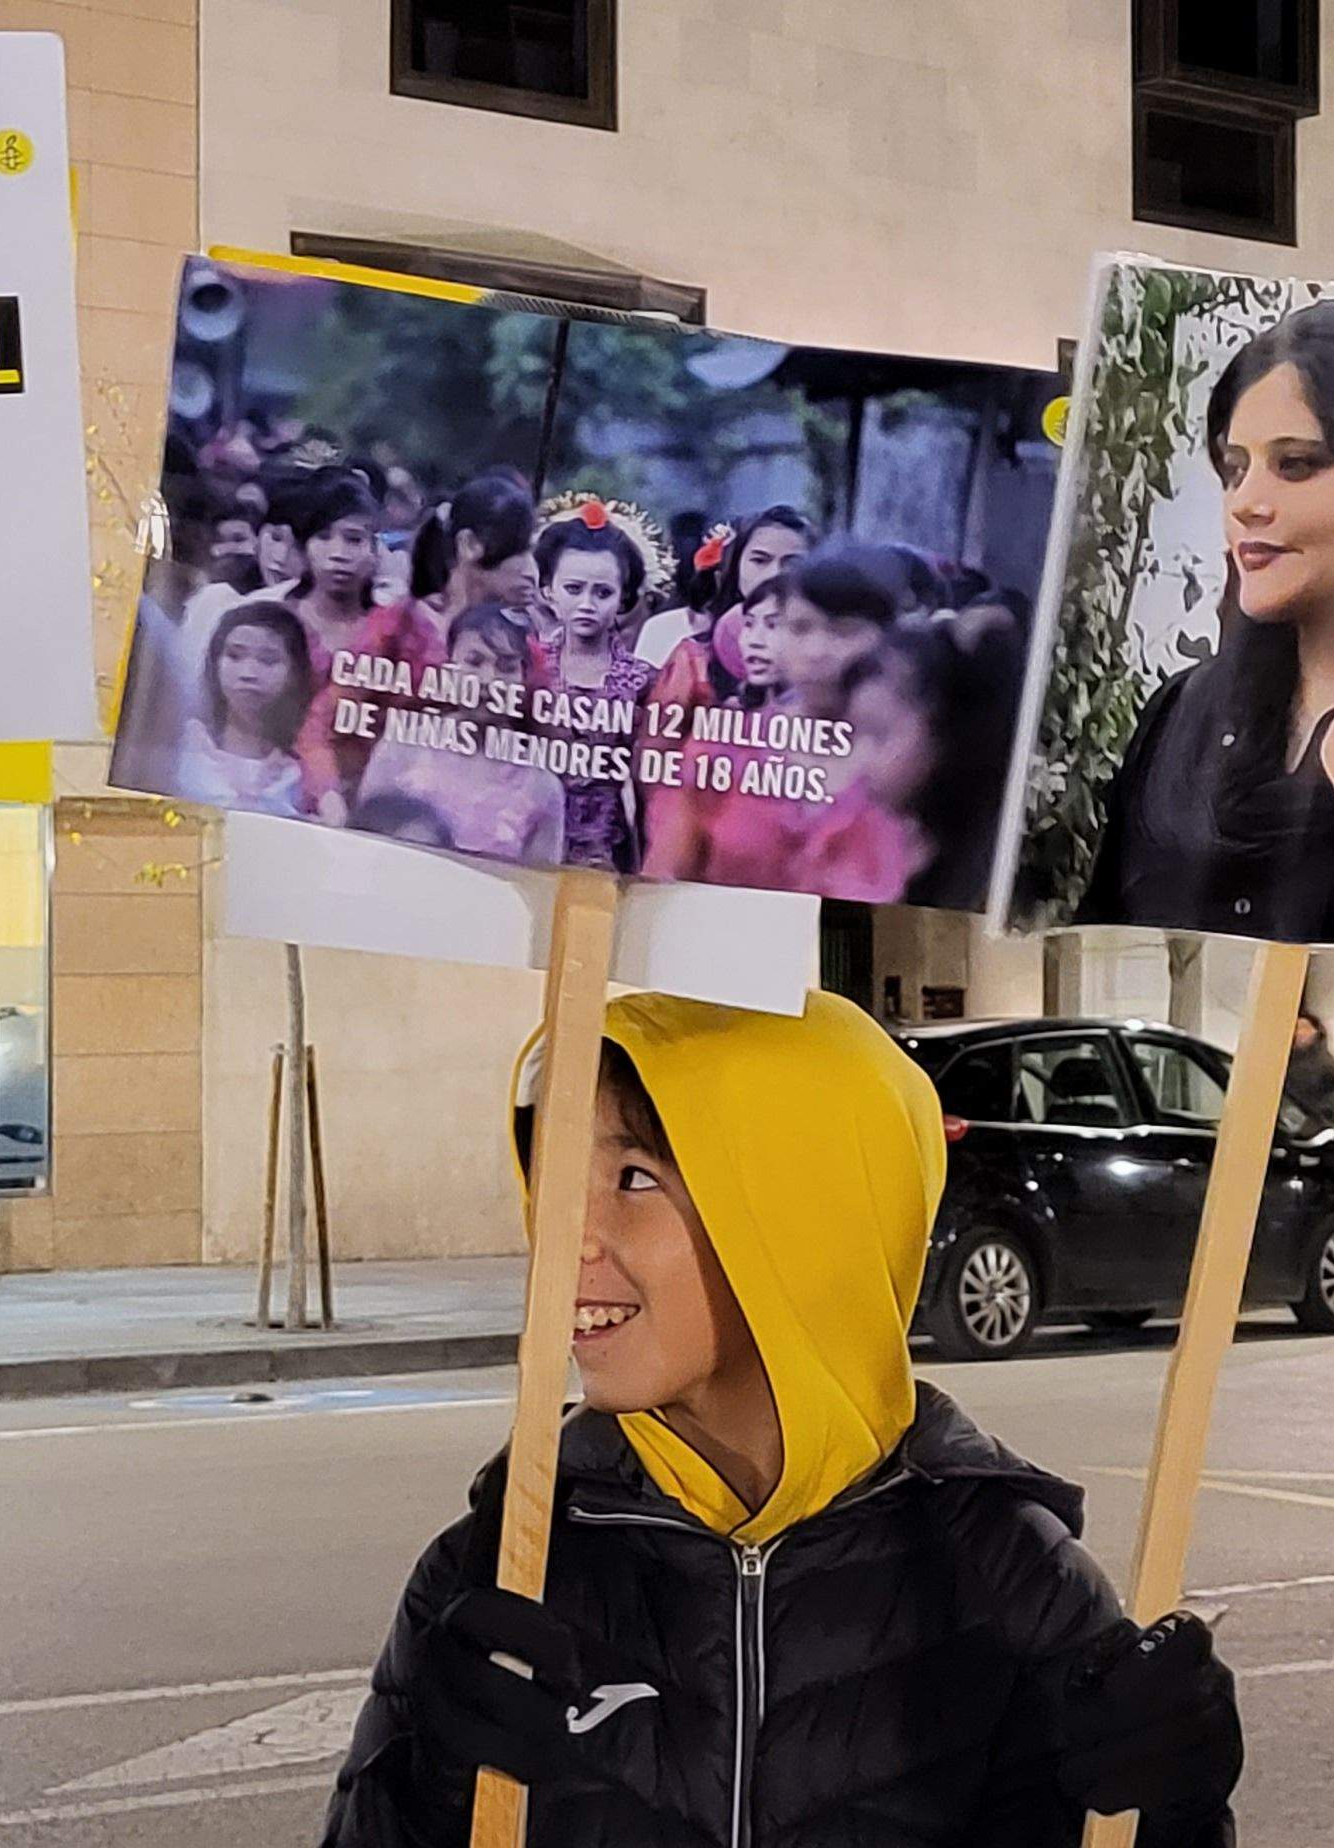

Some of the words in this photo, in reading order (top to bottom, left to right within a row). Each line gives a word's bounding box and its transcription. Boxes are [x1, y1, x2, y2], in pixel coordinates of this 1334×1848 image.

[331, 650, 413, 697] CADA
[418, 663, 481, 709] AÑO
[485, 680, 526, 718] SE
[532, 689, 633, 735] CASAN
[646, 703, 682, 740] 12
[693, 706, 854, 757] MILLONES
[334, 698, 374, 736] DE
[384, 704, 477, 757] NIÑAS
[484, 731, 631, 783] MENORES
[640, 749, 682, 787] DE
[694, 755, 731, 792] 18
[740, 756, 835, 804] AÑOS.
